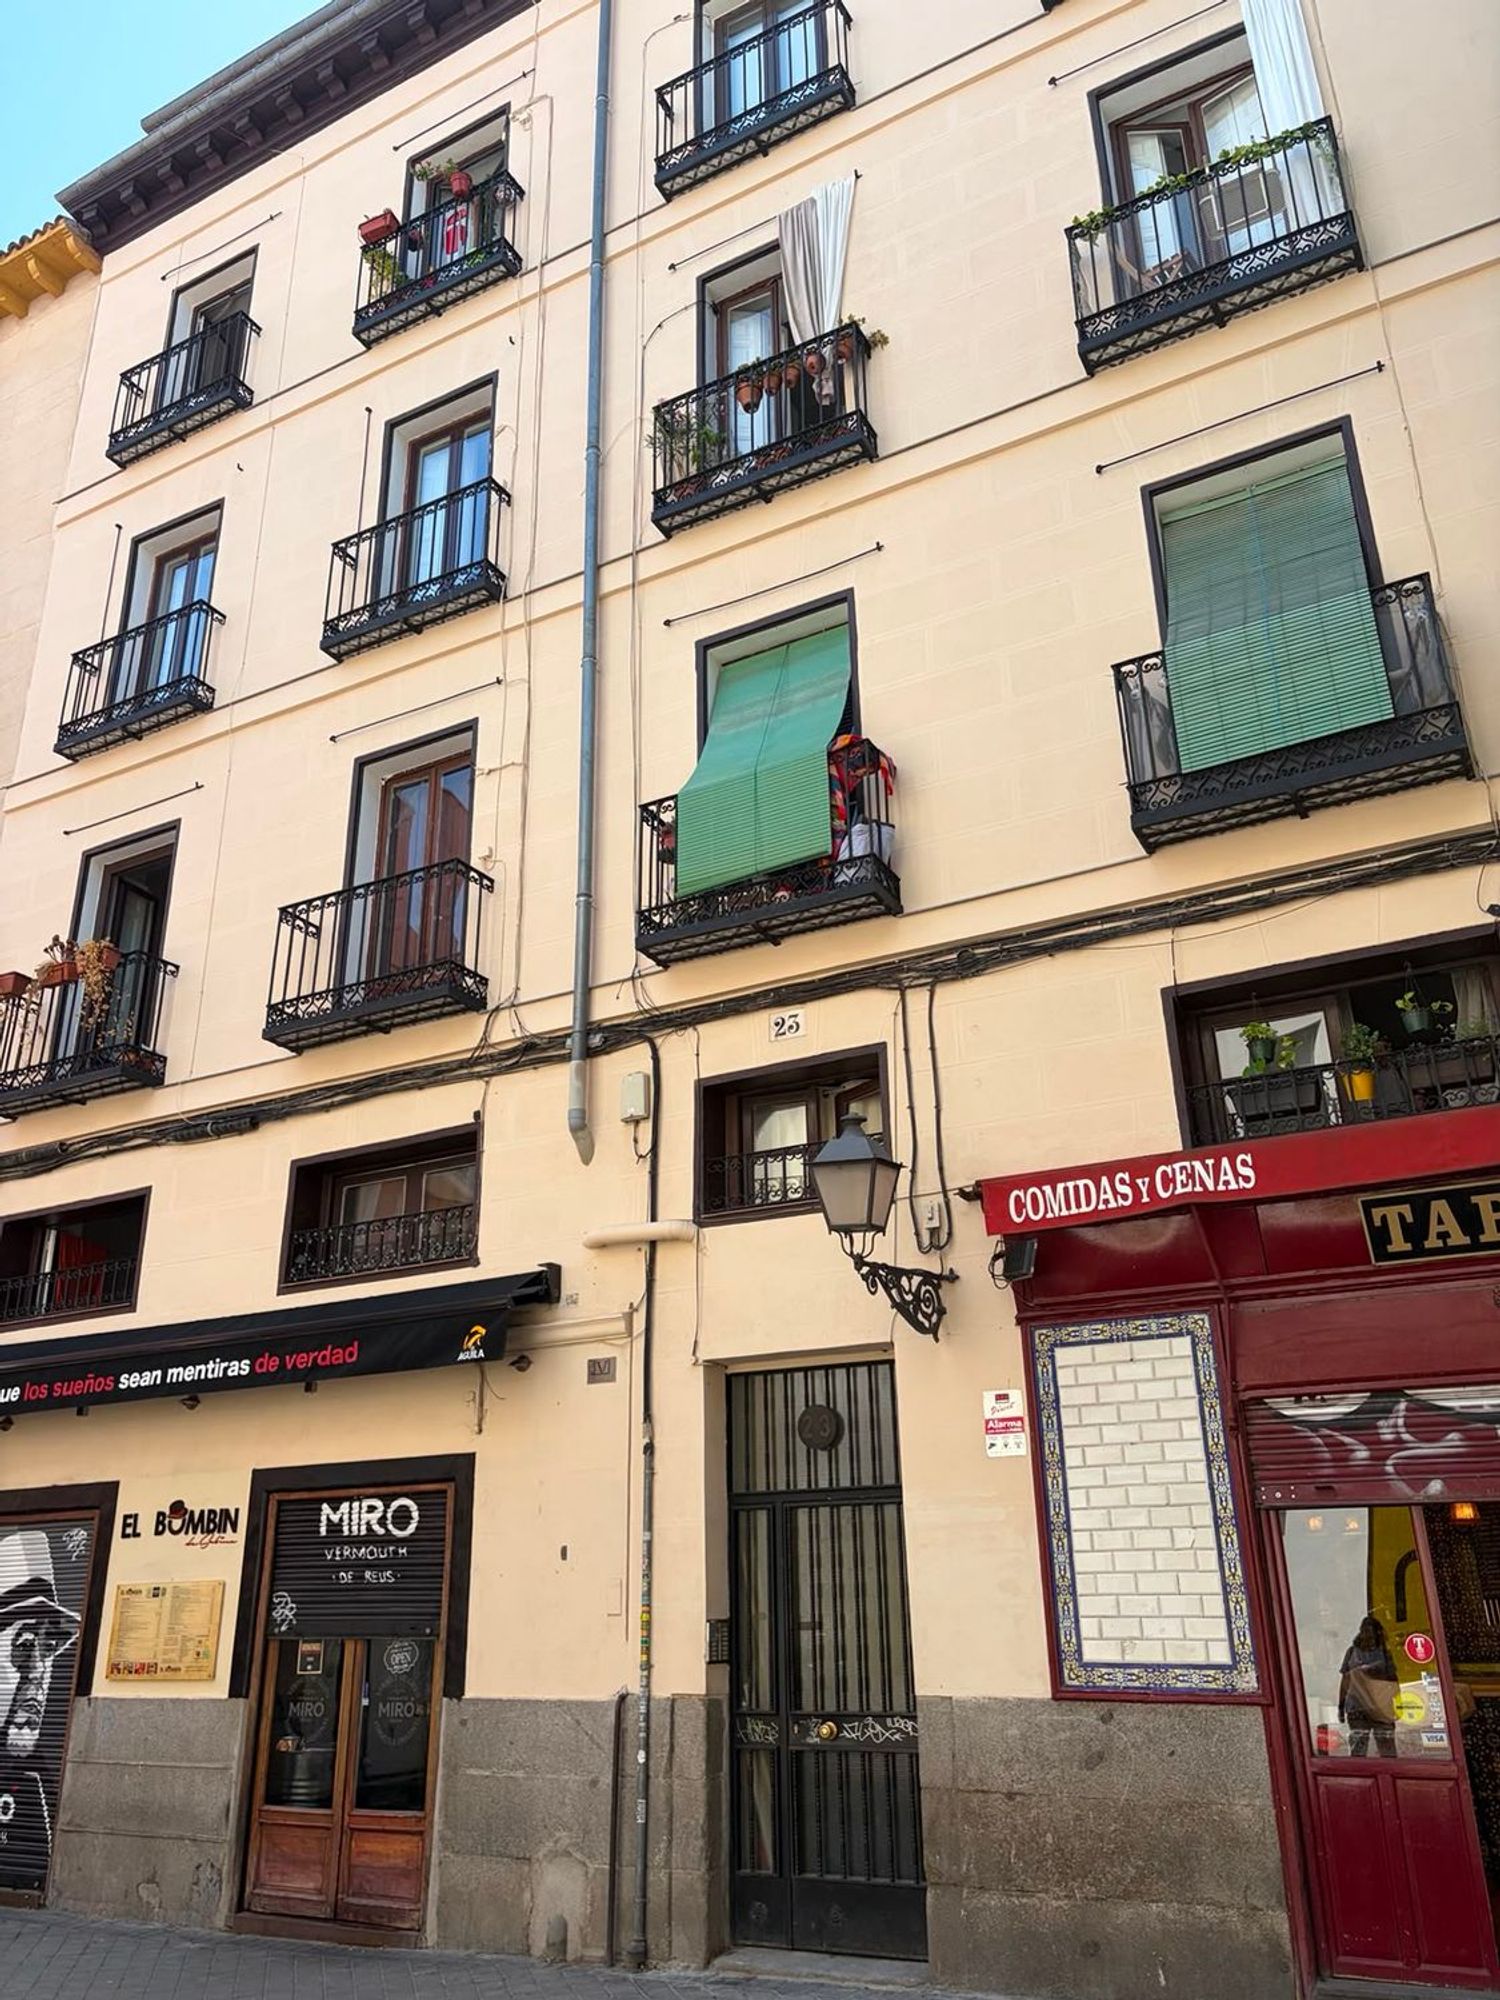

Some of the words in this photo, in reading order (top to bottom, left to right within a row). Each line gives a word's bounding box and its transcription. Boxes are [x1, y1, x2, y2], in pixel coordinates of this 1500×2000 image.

[774, 1013, 800, 1037] 23
[1008, 1171, 1131, 1224] COMIDAS
[1135, 1176, 1151, 1204] Y
[1155, 1152, 1256, 1199] CENAS
[0, 1386, 21, 1403] ue
[23, 1381, 49, 1402] los
[53, 1373, 114, 1398] sueños
[118, 1368, 162, 1389] sean
[166, 1357, 251, 1384] mentiras
[254, 1352, 280, 1374] de
[285, 1340, 359, 1371] verdad
[987, 1419, 1023, 1429] Alarma
[120, 1513, 142, 1539] EL
[154, 1507, 240, 1537] BOMBIN
[324, 1545, 408, 1560] VERMOUTH
[1425, 1734, 1445, 1743] VISA
